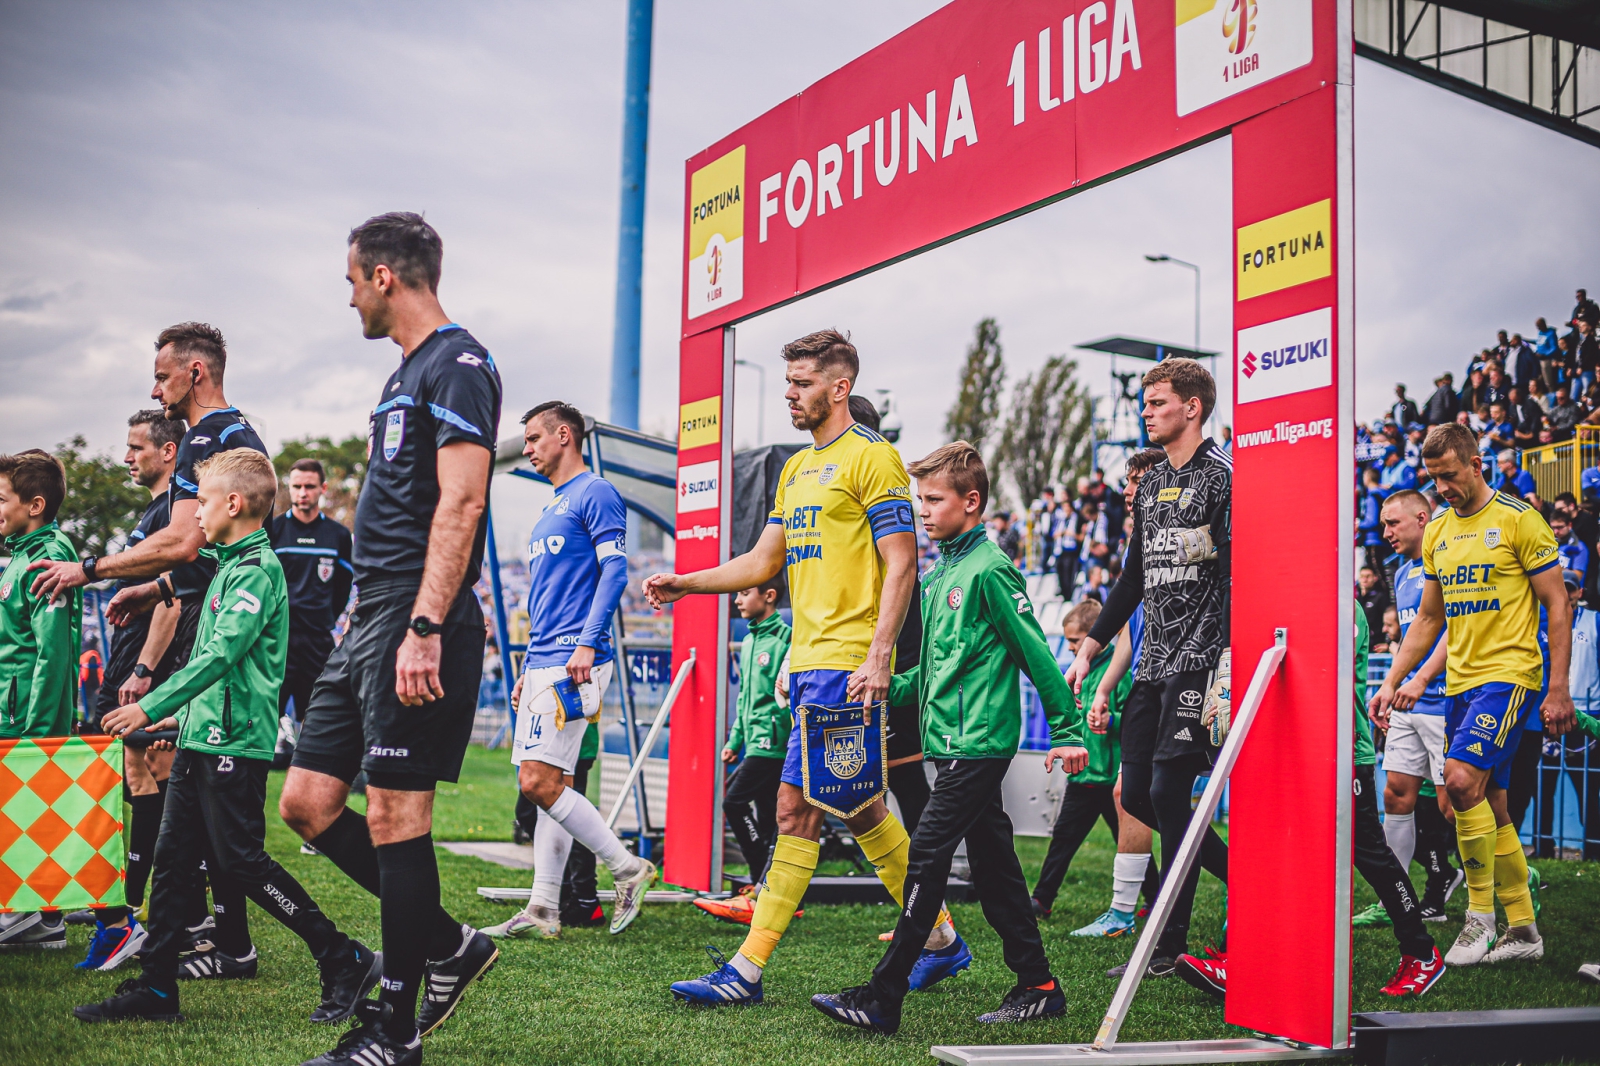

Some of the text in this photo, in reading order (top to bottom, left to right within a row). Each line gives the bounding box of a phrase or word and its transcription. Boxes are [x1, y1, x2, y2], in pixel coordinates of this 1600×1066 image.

[1223, 53, 1259, 82] 1 LIGA
[758, 0, 1142, 244] FORTUNA 1 LIGA
[693, 185, 741, 225] FORTUNA
[1243, 230, 1325, 273] FORTUNA
[711, 287, 722, 301] LIGA
[1261, 338, 1328, 371] SUZUKI
[388, 414, 401, 426] FIFA
[682, 414, 717, 433] FORTUNA
[1237, 418, 1333, 449] www.1liga.org
[688, 478, 717, 494] SUZUKI
[896, 505, 912, 526] C
[1453, 533, 1477, 541] FORTUNA
[529, 538, 546, 561] LBA
[1445, 598, 1501, 618] GDYNIA
[1176, 711, 1200, 720] WALDER
[206, 726, 222, 745] 25
[529, 714, 542, 739] 14
[1469, 729, 1492, 742] WALDER
[758, 737, 772, 751] 34
[941, 734, 952, 752] 7
[217, 755, 234, 772] 25
[832, 753, 859, 763] ARKA
[263, 883, 299, 915] SPROX
[907, 882, 921, 911] PATRICK
[1395, 881, 1415, 912] SPROX
